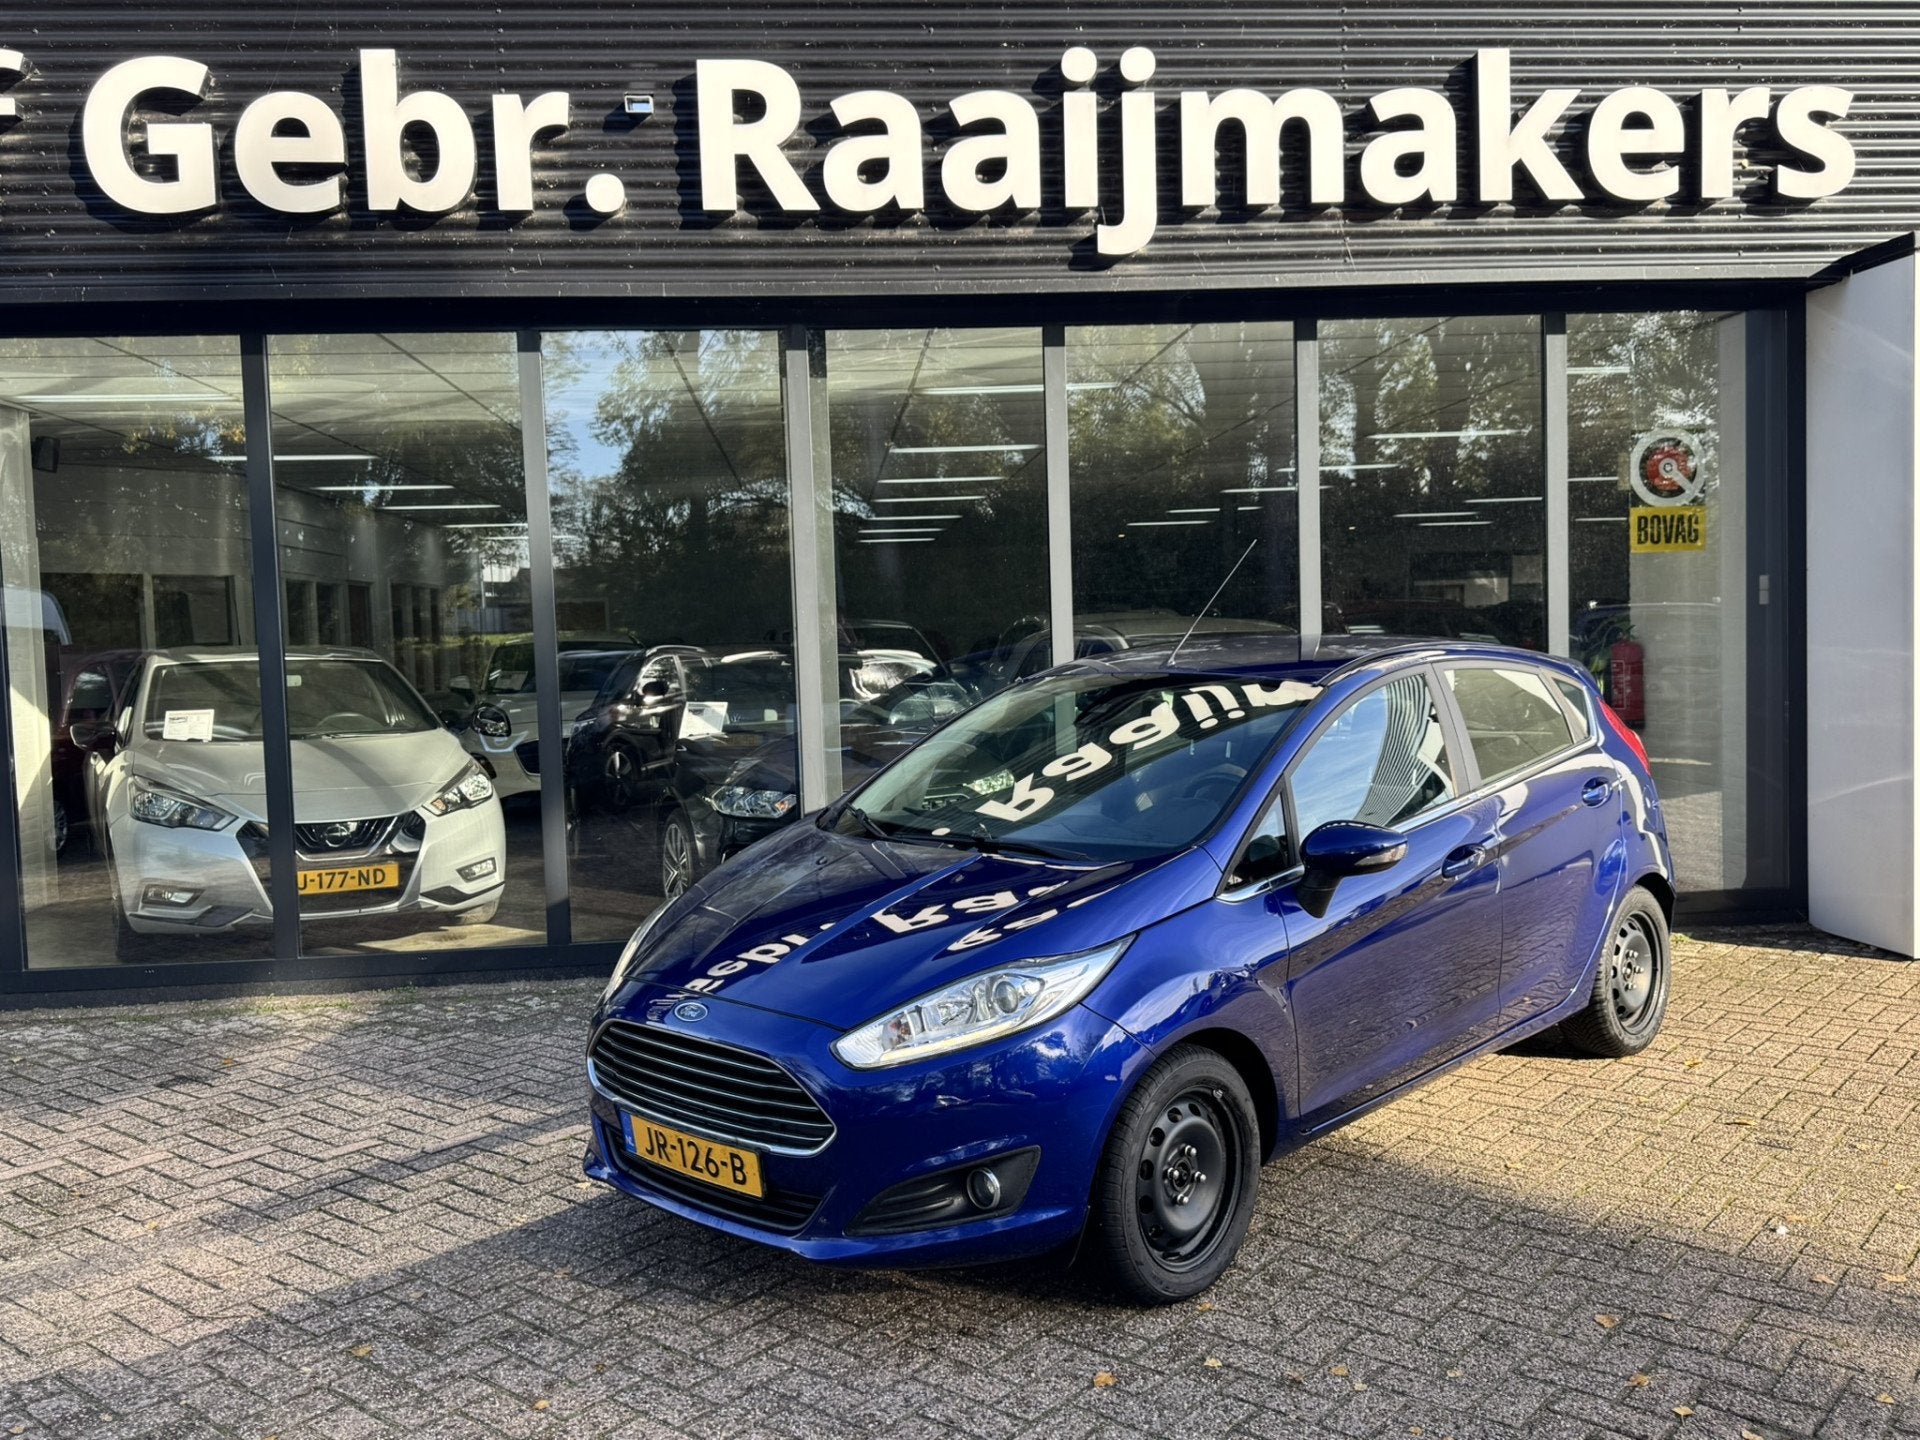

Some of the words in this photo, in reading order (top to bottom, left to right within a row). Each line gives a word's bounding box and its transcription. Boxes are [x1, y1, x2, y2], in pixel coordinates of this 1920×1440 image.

[83, 49, 626, 214] Gebr.
[696, 46, 1857, 255] Raaijmakers
[1637, 513, 1700, 545] BOVAG
[298, 868, 386, 890] J-177-ND
[645, 1126, 748, 1186] JR-126-B
